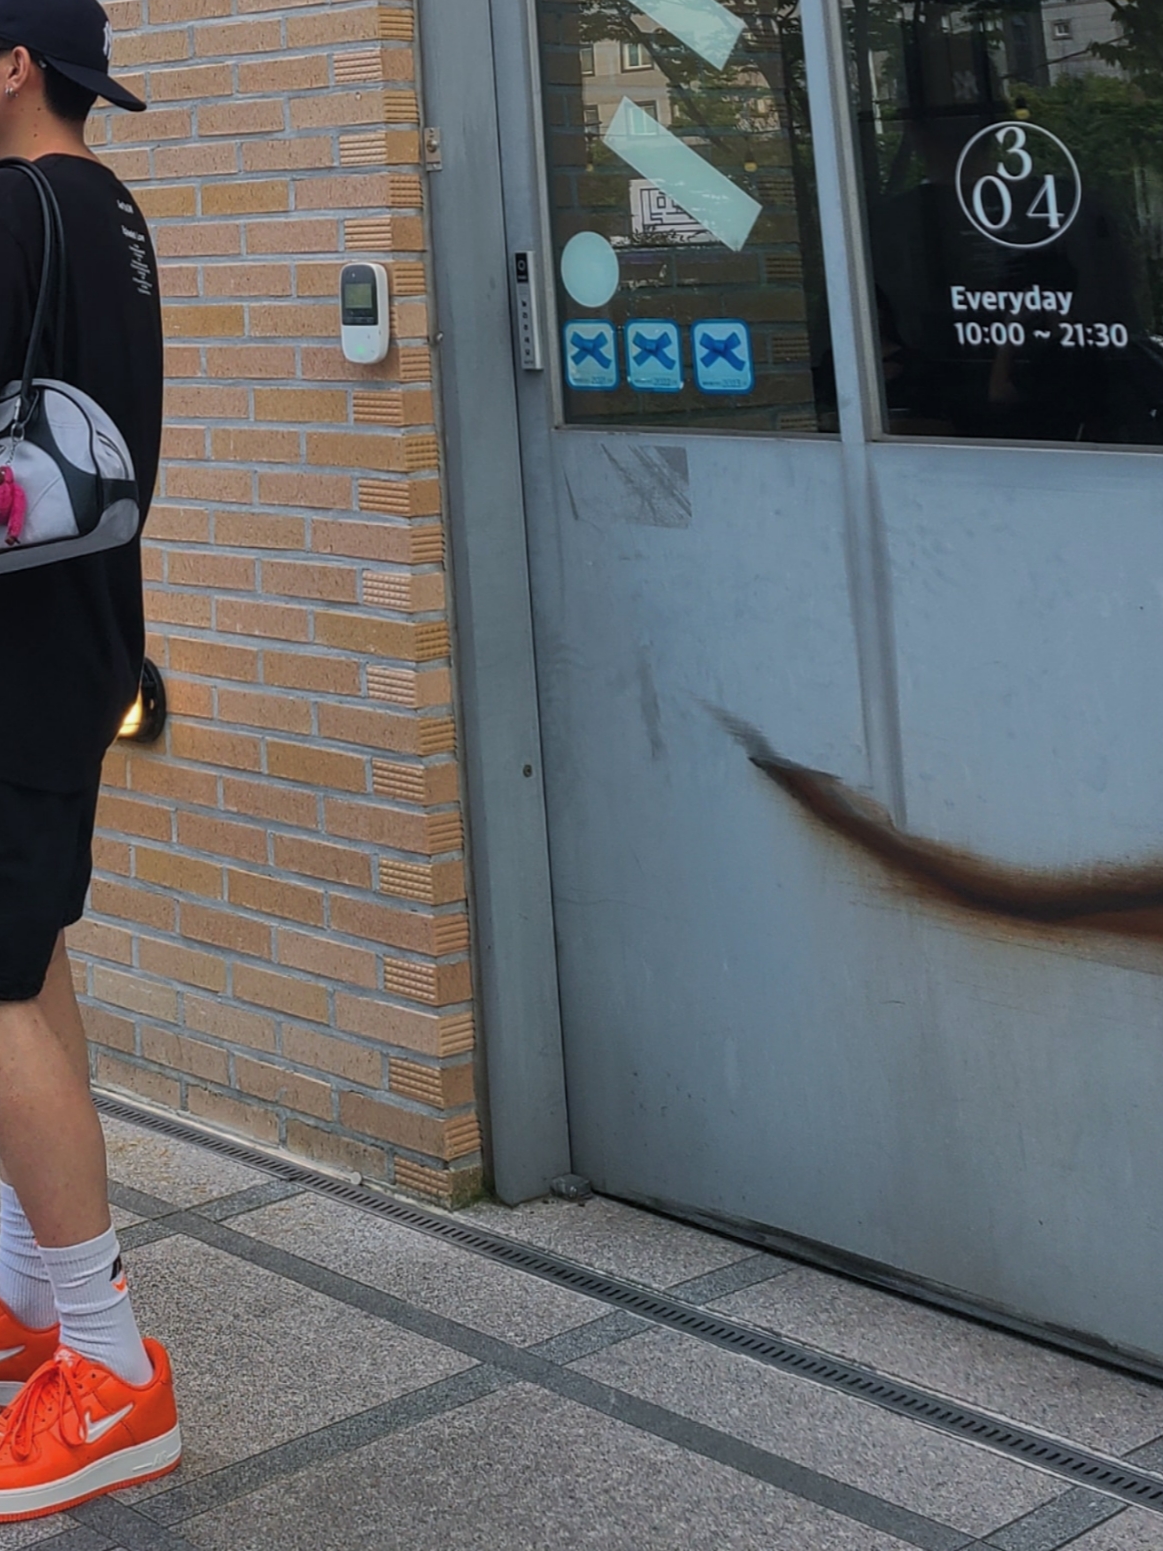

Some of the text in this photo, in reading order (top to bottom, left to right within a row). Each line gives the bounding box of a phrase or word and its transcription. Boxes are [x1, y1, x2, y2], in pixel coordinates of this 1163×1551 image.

[951, 285, 1072, 314] Everyday
[953, 321, 1026, 346] 10:00
[1058, 322, 1129, 347] 21:30
